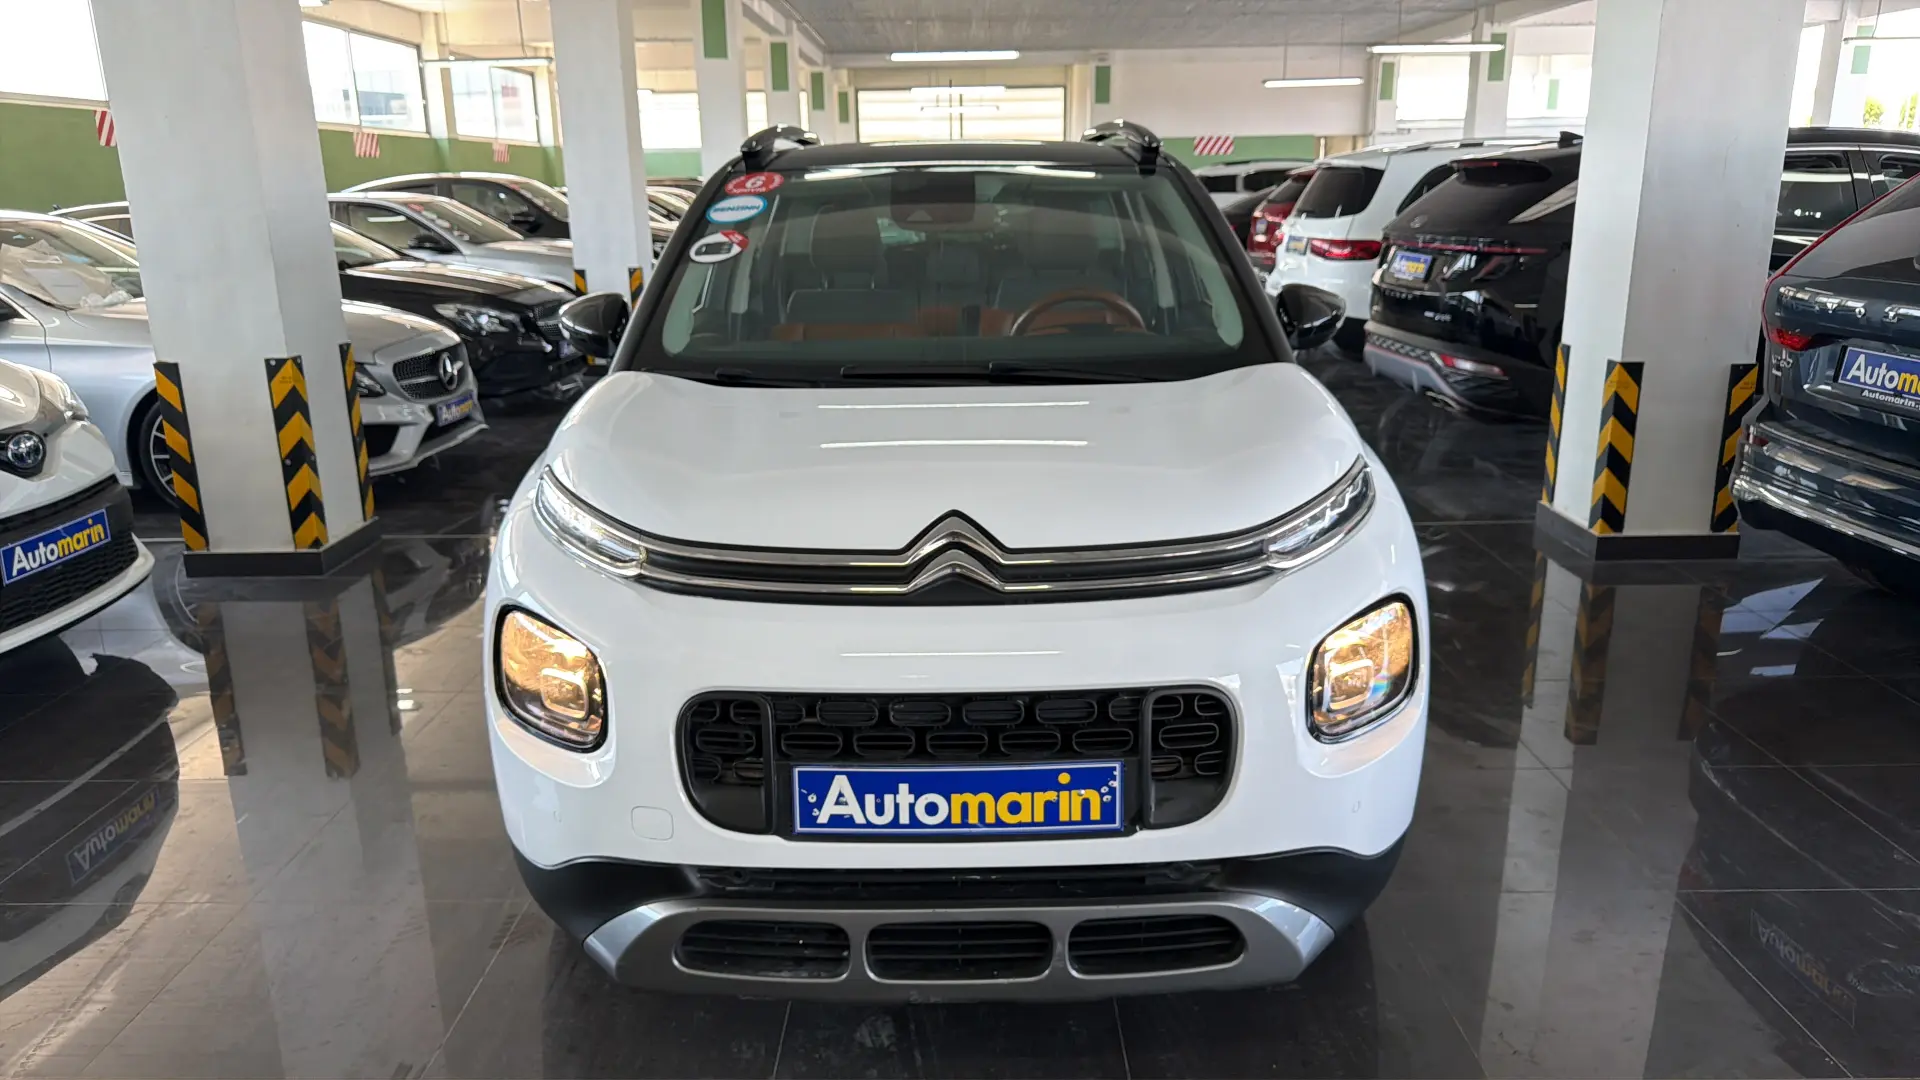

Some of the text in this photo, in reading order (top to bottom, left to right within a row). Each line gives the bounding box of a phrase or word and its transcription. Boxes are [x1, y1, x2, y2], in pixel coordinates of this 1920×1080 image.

[1846, 353, 1920, 395] Autom
[12, 518, 105, 577] Automarin
[816, 772, 1101, 825] Automarin
